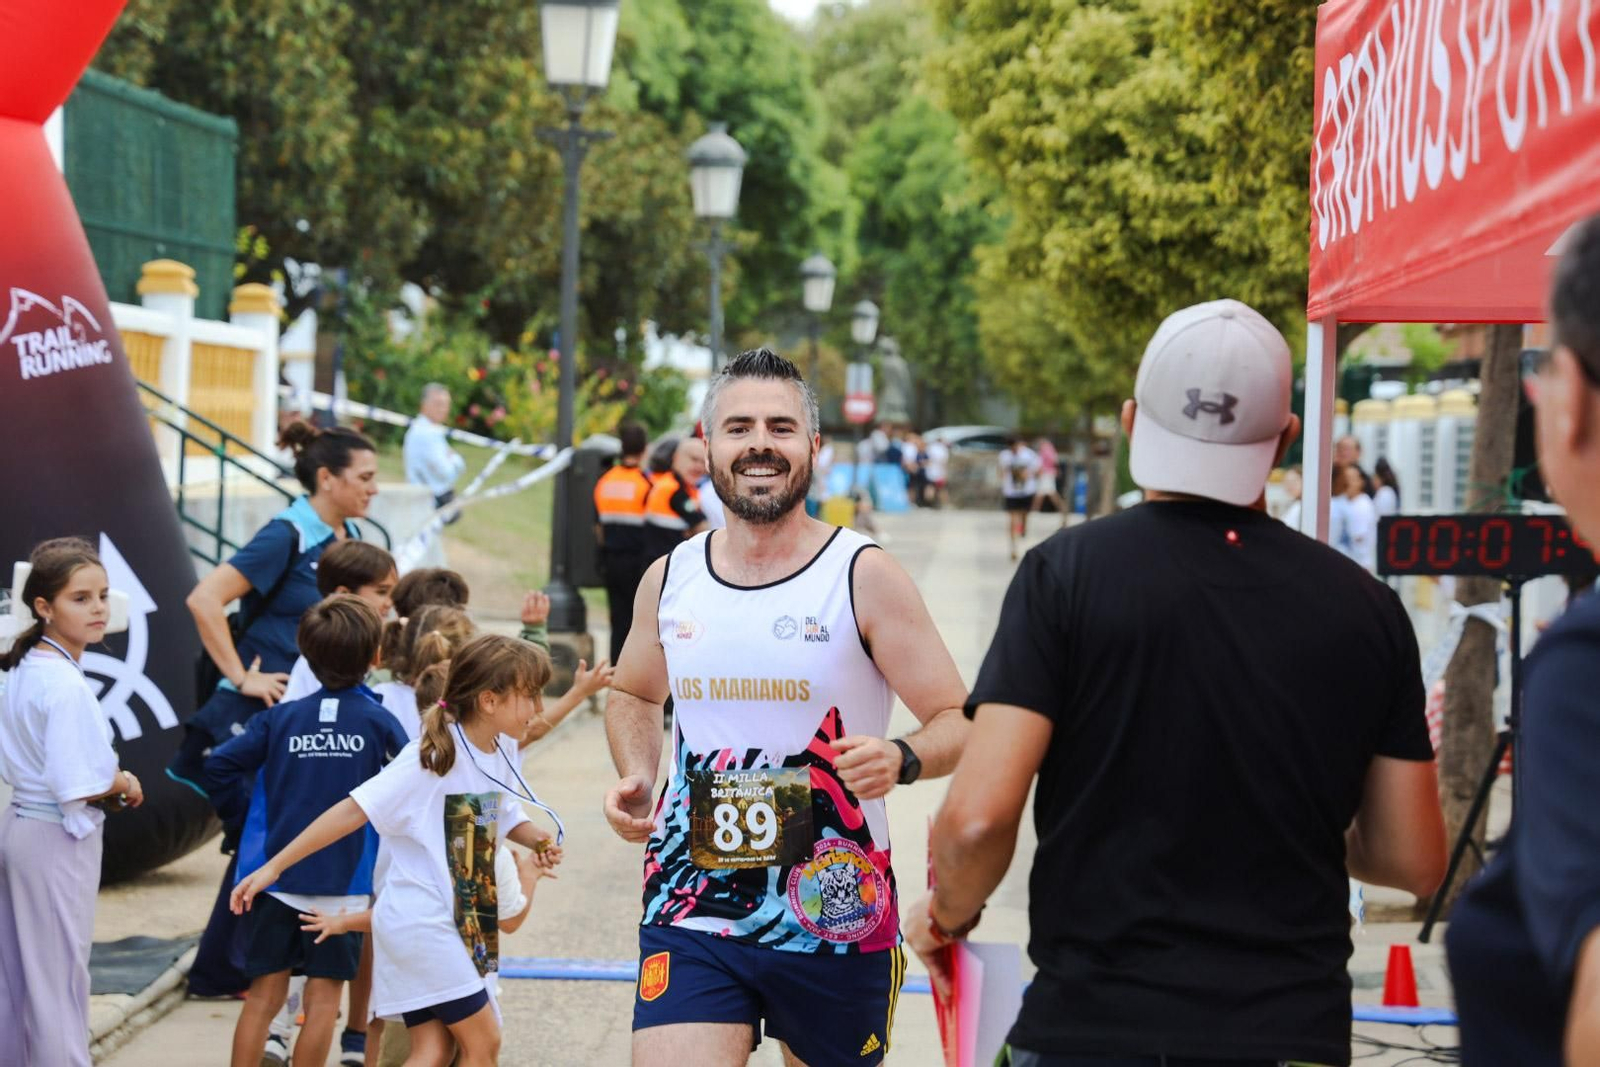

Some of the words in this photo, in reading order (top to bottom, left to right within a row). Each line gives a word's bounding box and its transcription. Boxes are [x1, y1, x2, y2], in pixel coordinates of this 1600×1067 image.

[10, 325, 77, 359] TRAIL
[20, 339, 113, 380] RUNNING
[805, 616, 817, 625] DEL
[820, 625, 829, 633] AL
[804, 633, 830, 643] MUNDO
[675, 677, 702, 700] LOS
[709, 677, 811, 702] MARIANOS
[288, 733, 365, 753] DECANO
[712, 774, 726, 784] II
[728, 772, 768, 784] MILLA
[711, 785, 774, 799] BRITÁNICA
[713, 801, 778, 852] 89
